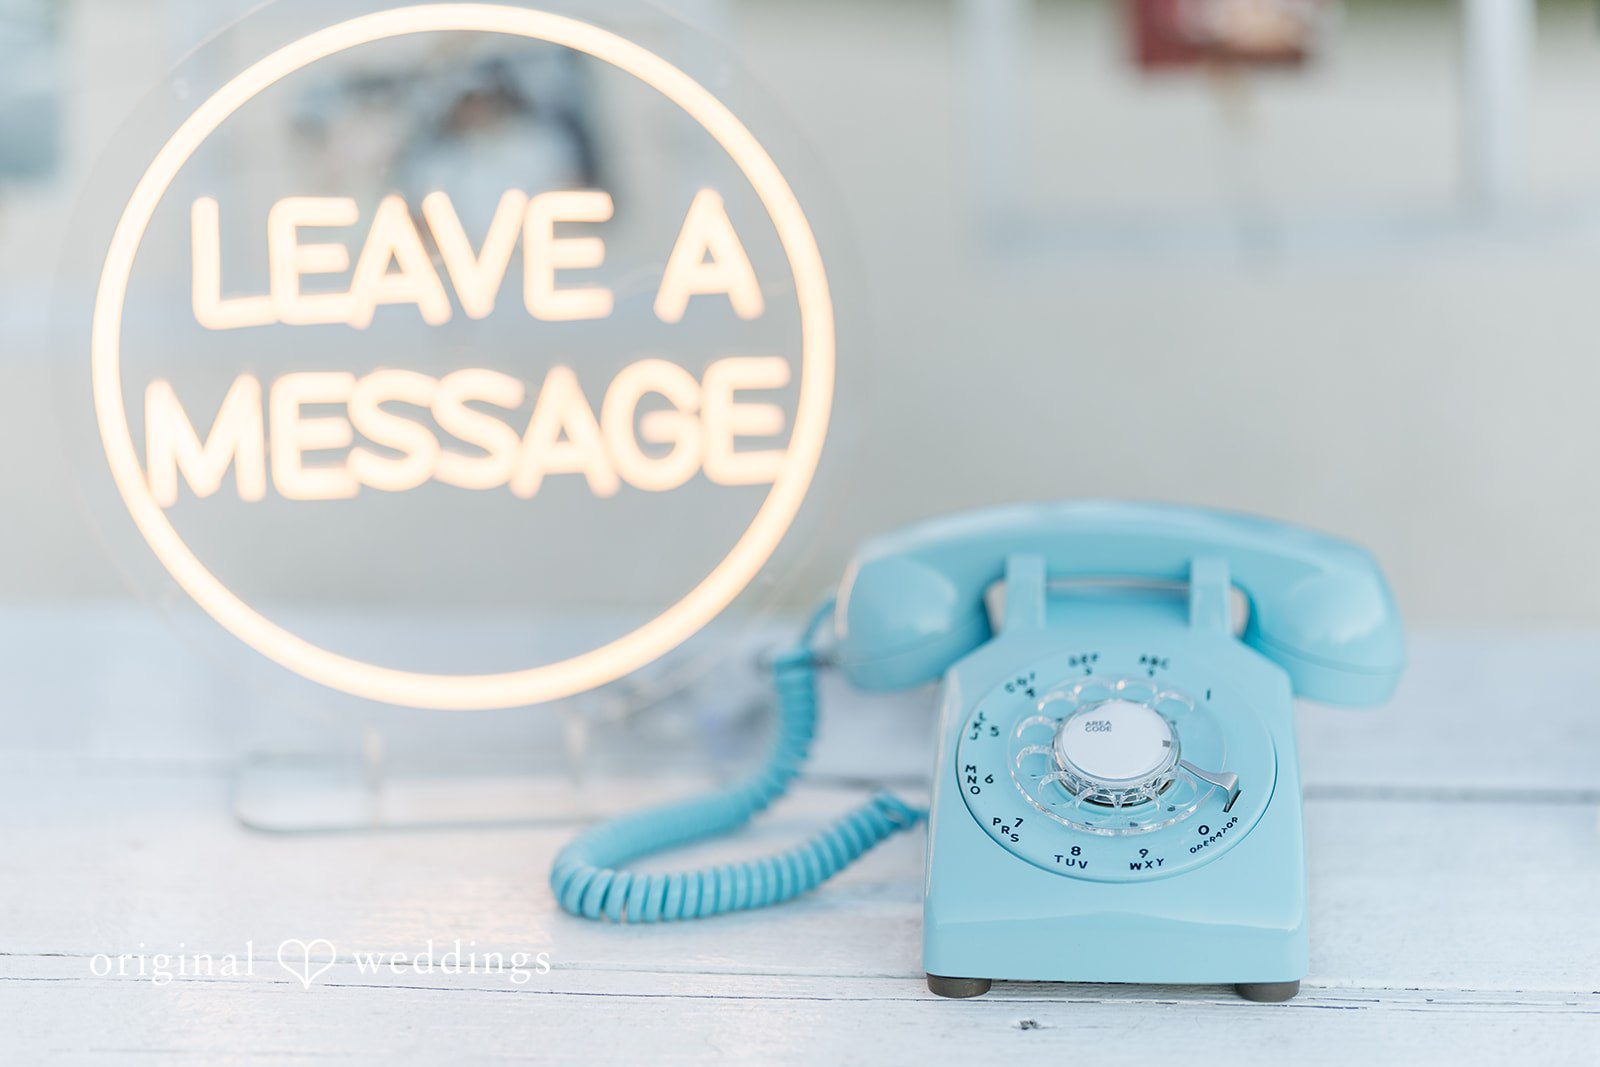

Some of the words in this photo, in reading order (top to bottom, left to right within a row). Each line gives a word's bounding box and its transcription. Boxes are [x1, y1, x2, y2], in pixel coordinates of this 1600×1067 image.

[191, 187, 614, 330] LEAVE
[654, 187, 765, 323] A
[144, 356, 791, 508] MESSAGE
[985, 774, 994, 784] 6
[1014, 818, 1024, 828] 7
[1189, 816, 1239, 854] OPERATOR
[1070, 846, 1081, 856] 8
[1138, 848, 1149, 859] 9
[1054, 854, 1089, 870] TUV
[1129, 858, 1165, 871] WXY
